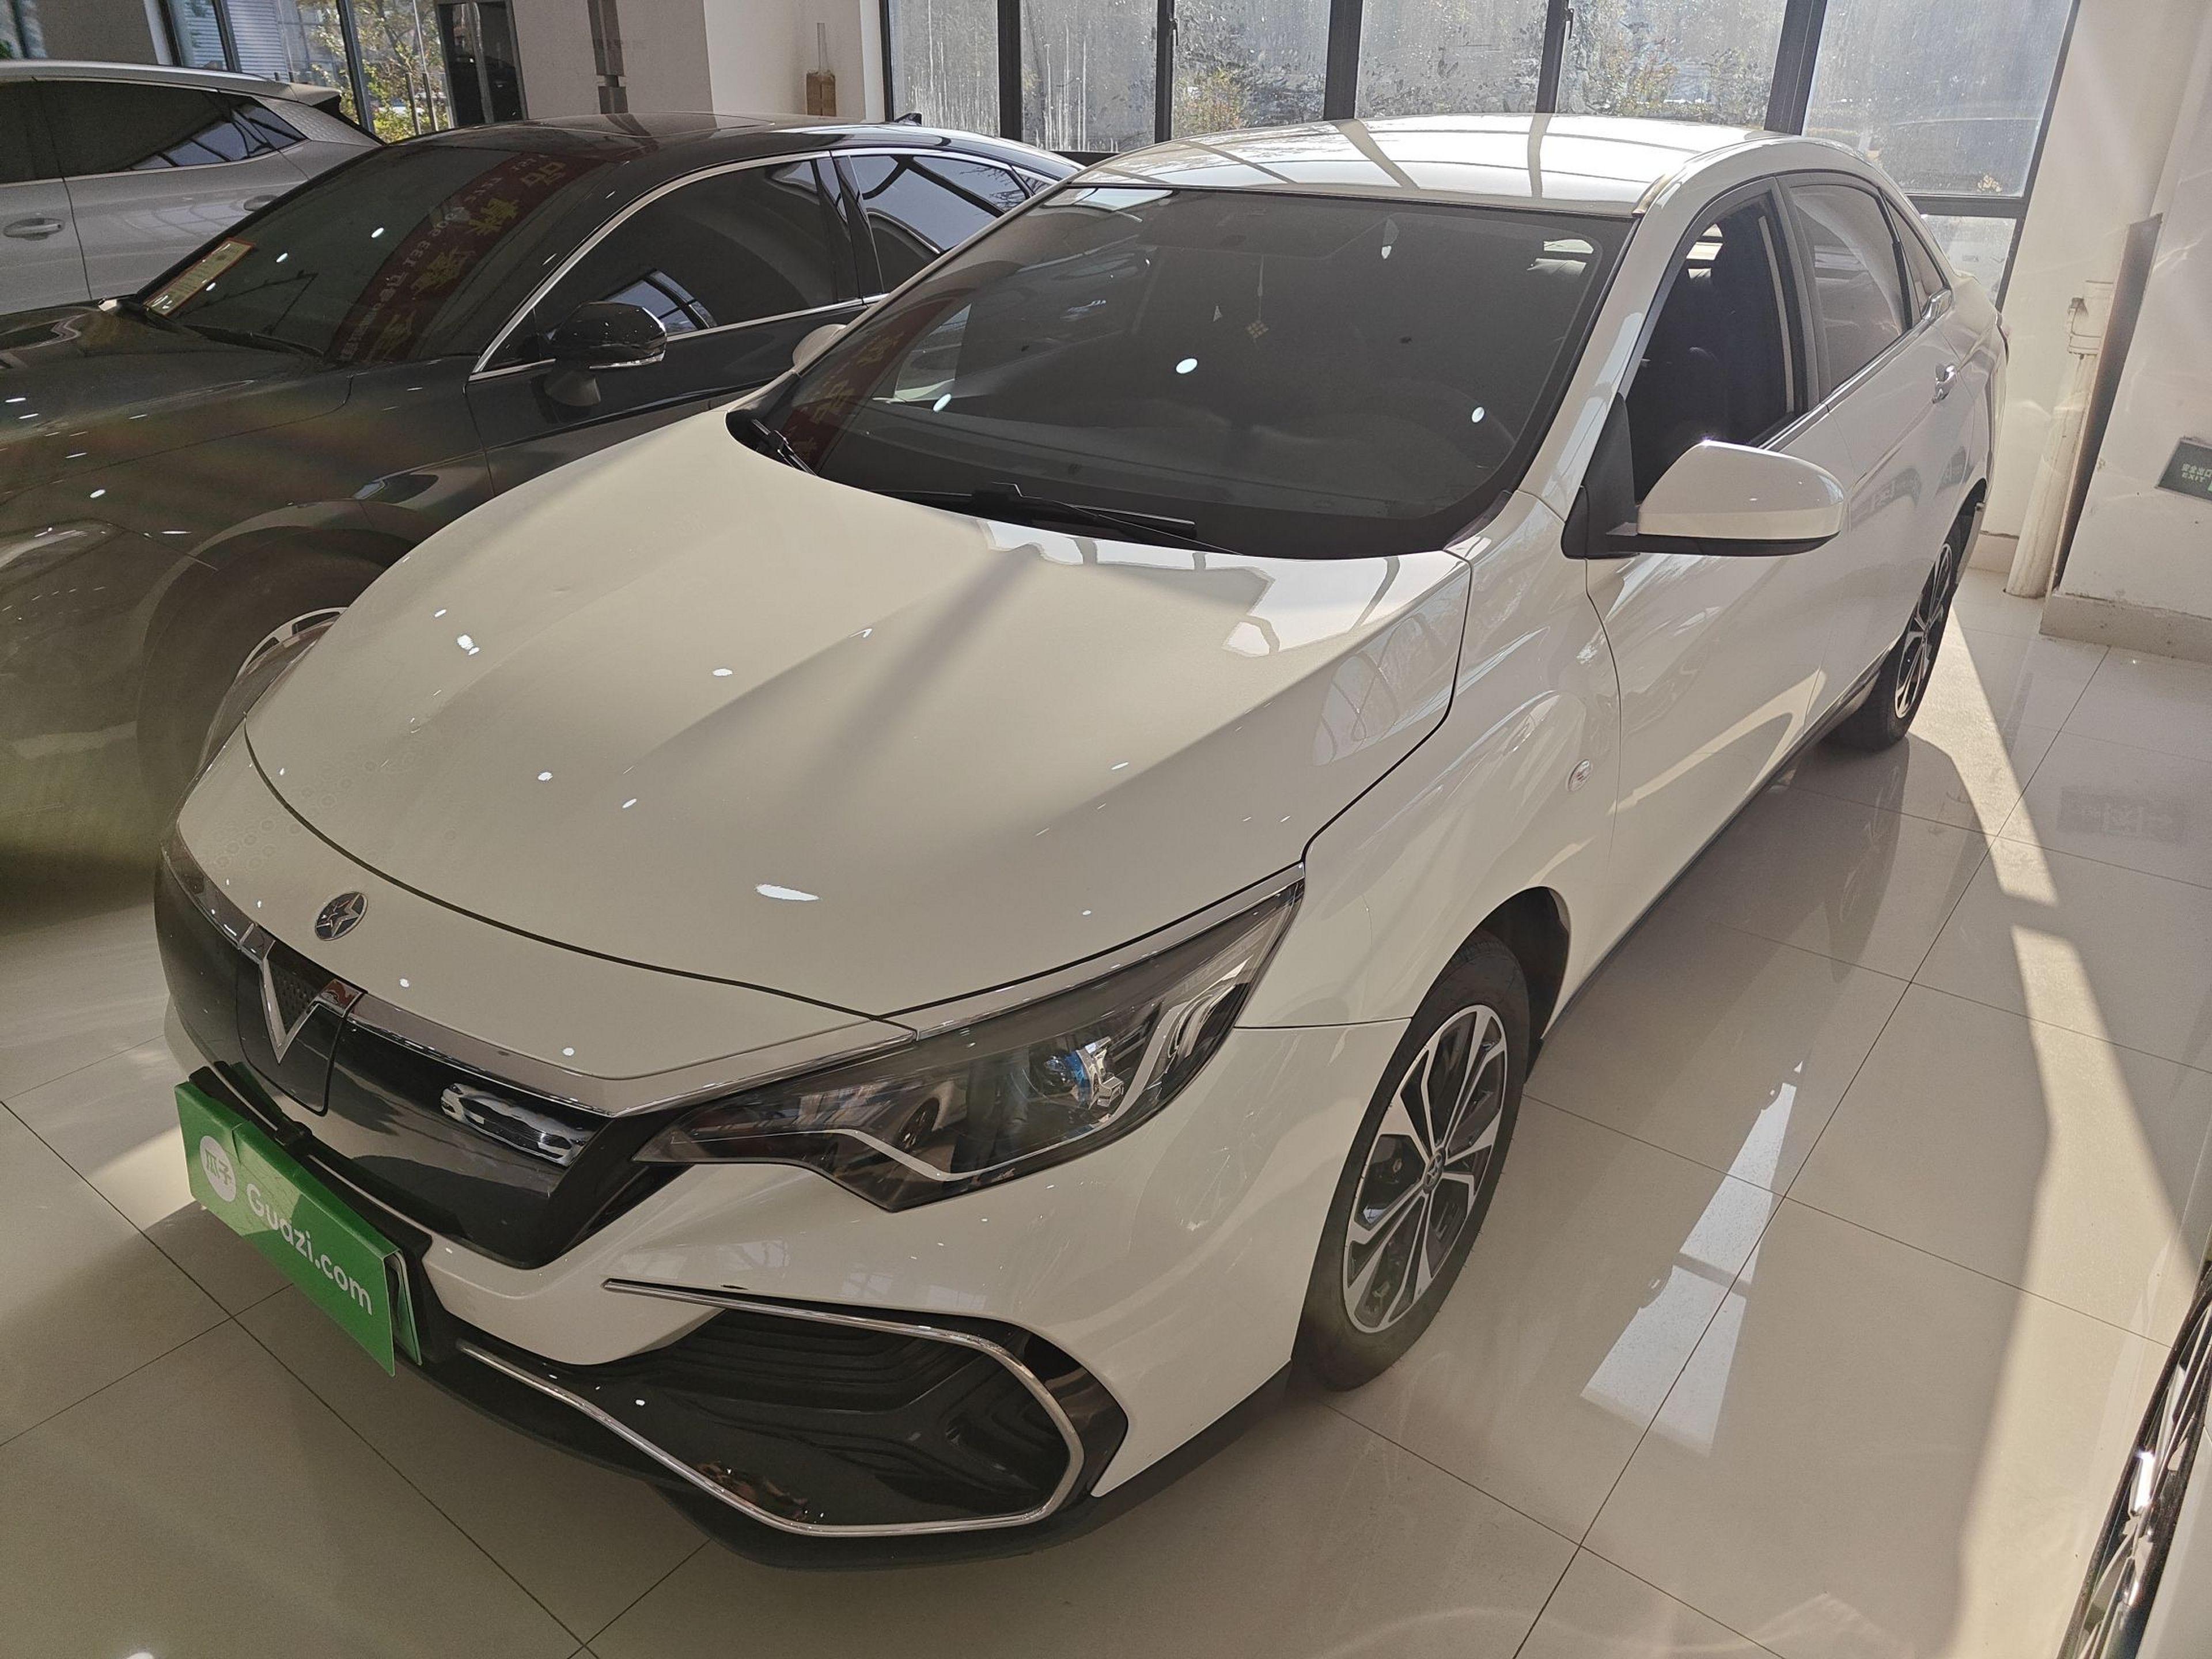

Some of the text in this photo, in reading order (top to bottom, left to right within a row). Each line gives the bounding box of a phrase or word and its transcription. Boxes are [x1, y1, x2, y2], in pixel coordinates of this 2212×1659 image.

[2182, 472, 2206, 482] EXIT
[205, 1148, 232, 1185] 瓜子
[246, 1183, 372, 1316] Guazi.com
